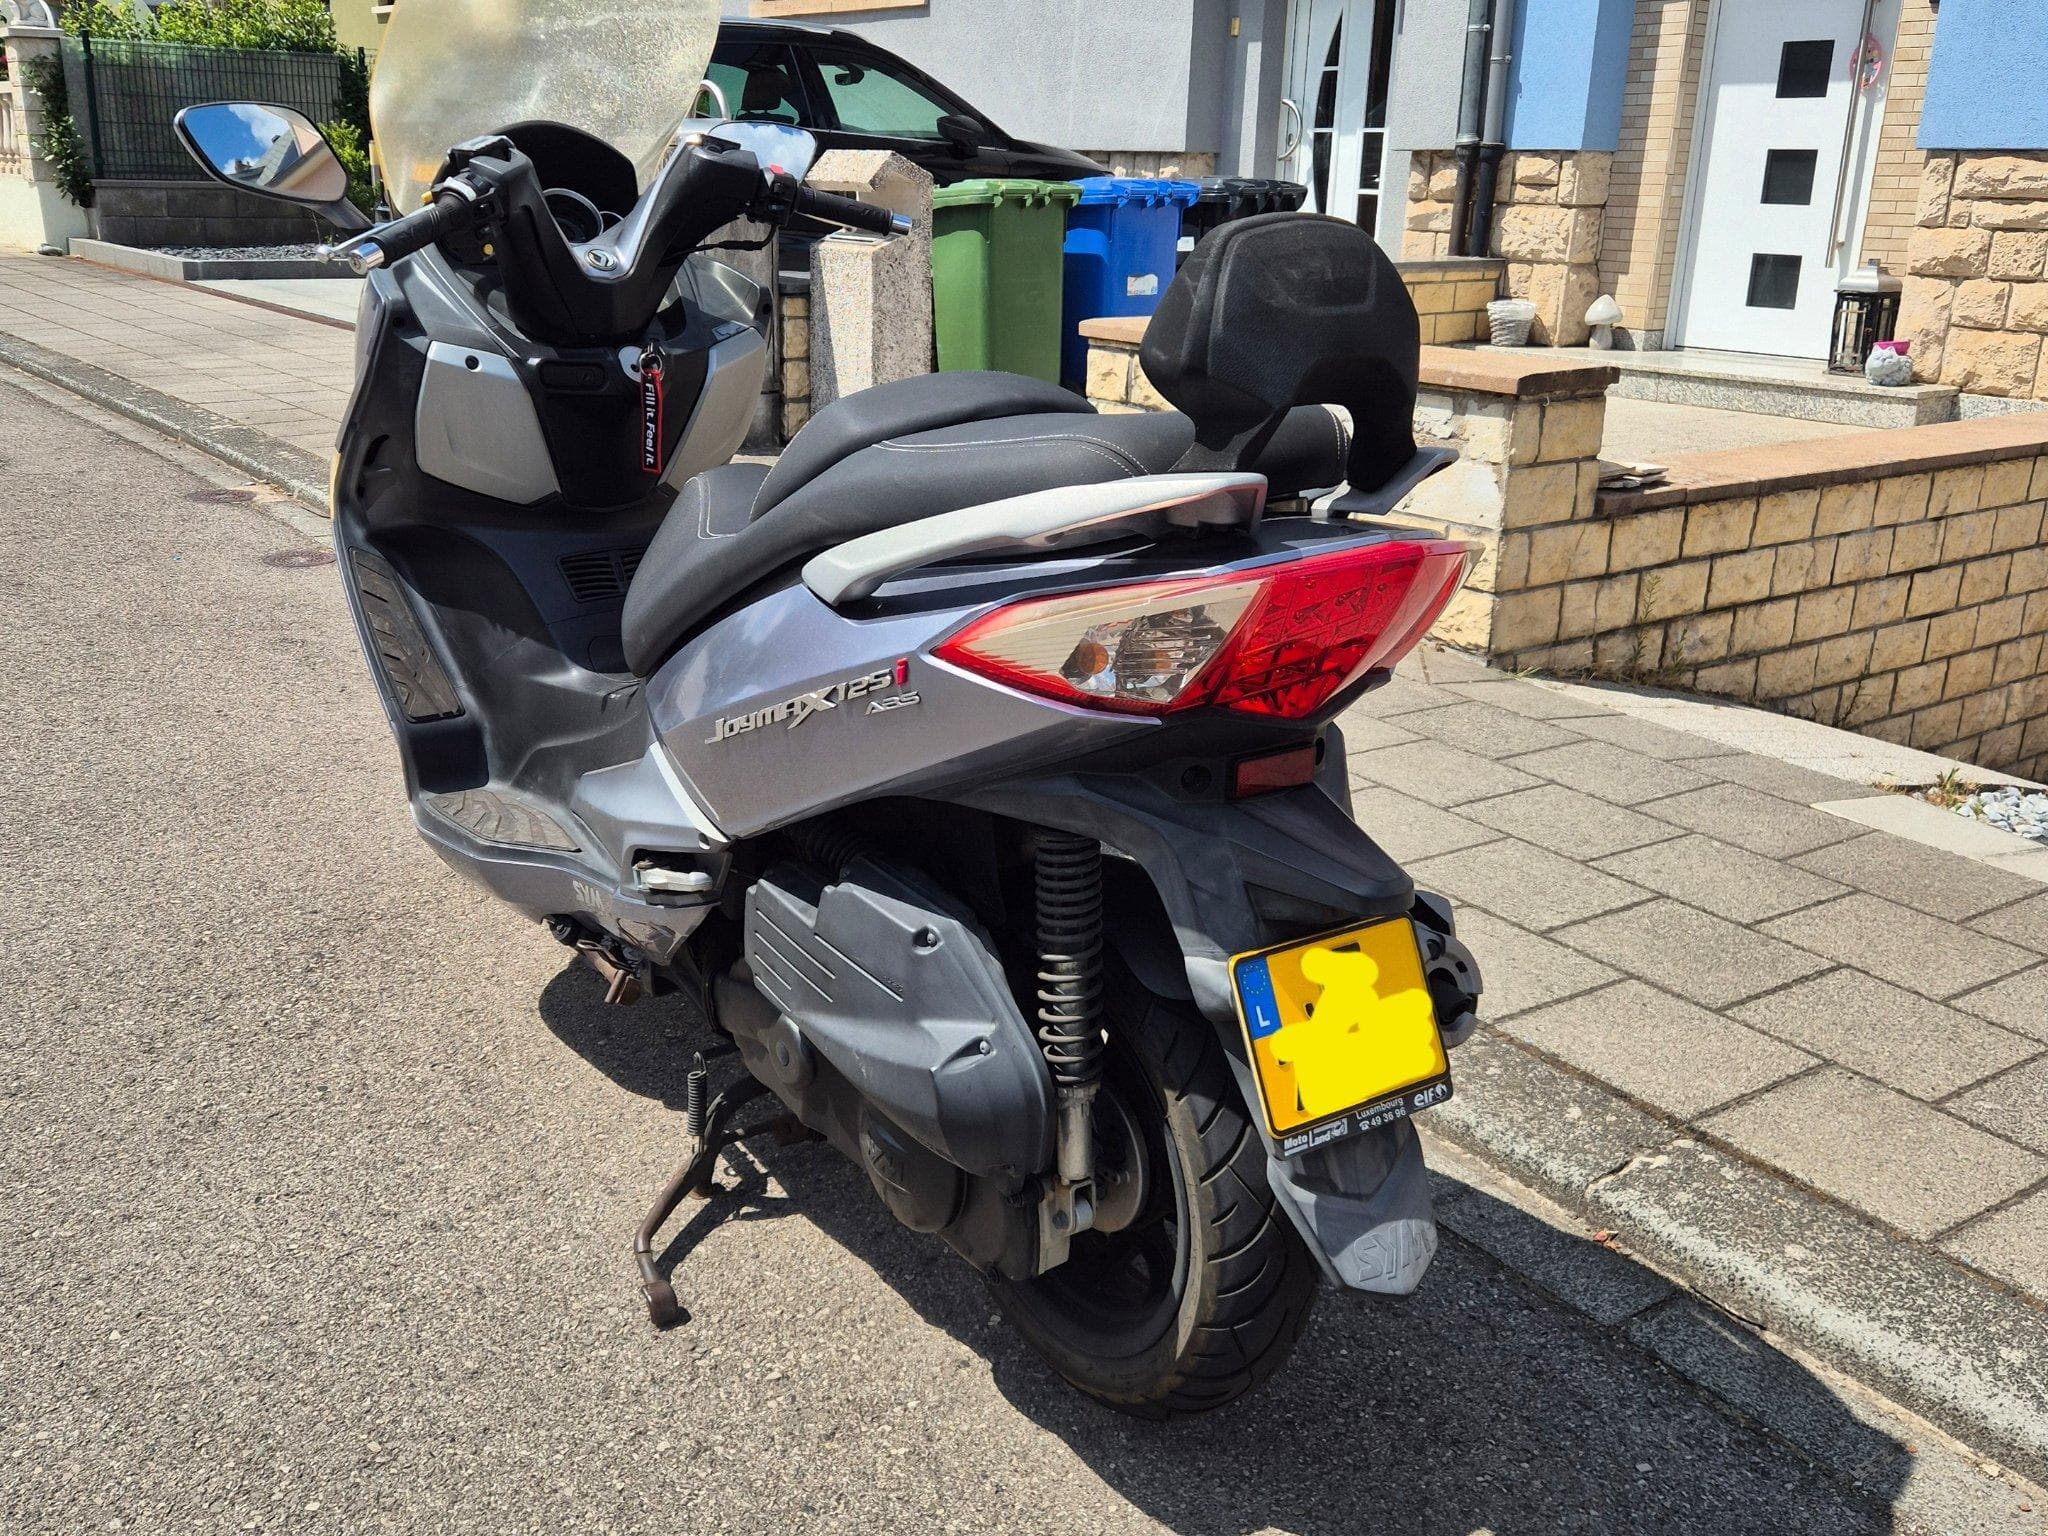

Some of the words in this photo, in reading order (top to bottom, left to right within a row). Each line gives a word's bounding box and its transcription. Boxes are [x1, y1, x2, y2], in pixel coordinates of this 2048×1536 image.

[645, 383, 656, 405] Fill
[646, 422, 655, 453] Feel
[864, 690, 921, 716] ABS
[1256, 1005, 1271, 1028] L
[1355, 1097, 1404, 1120] Luxembourg
[1413, 1088, 1435, 1107] elf
[1370, 1115, 1382, 1127] 49
[1284, 1134, 1308, 1150] Moto
[1308, 1129, 1331, 1148] Land
[1354, 1218, 1432, 1282] SYM
